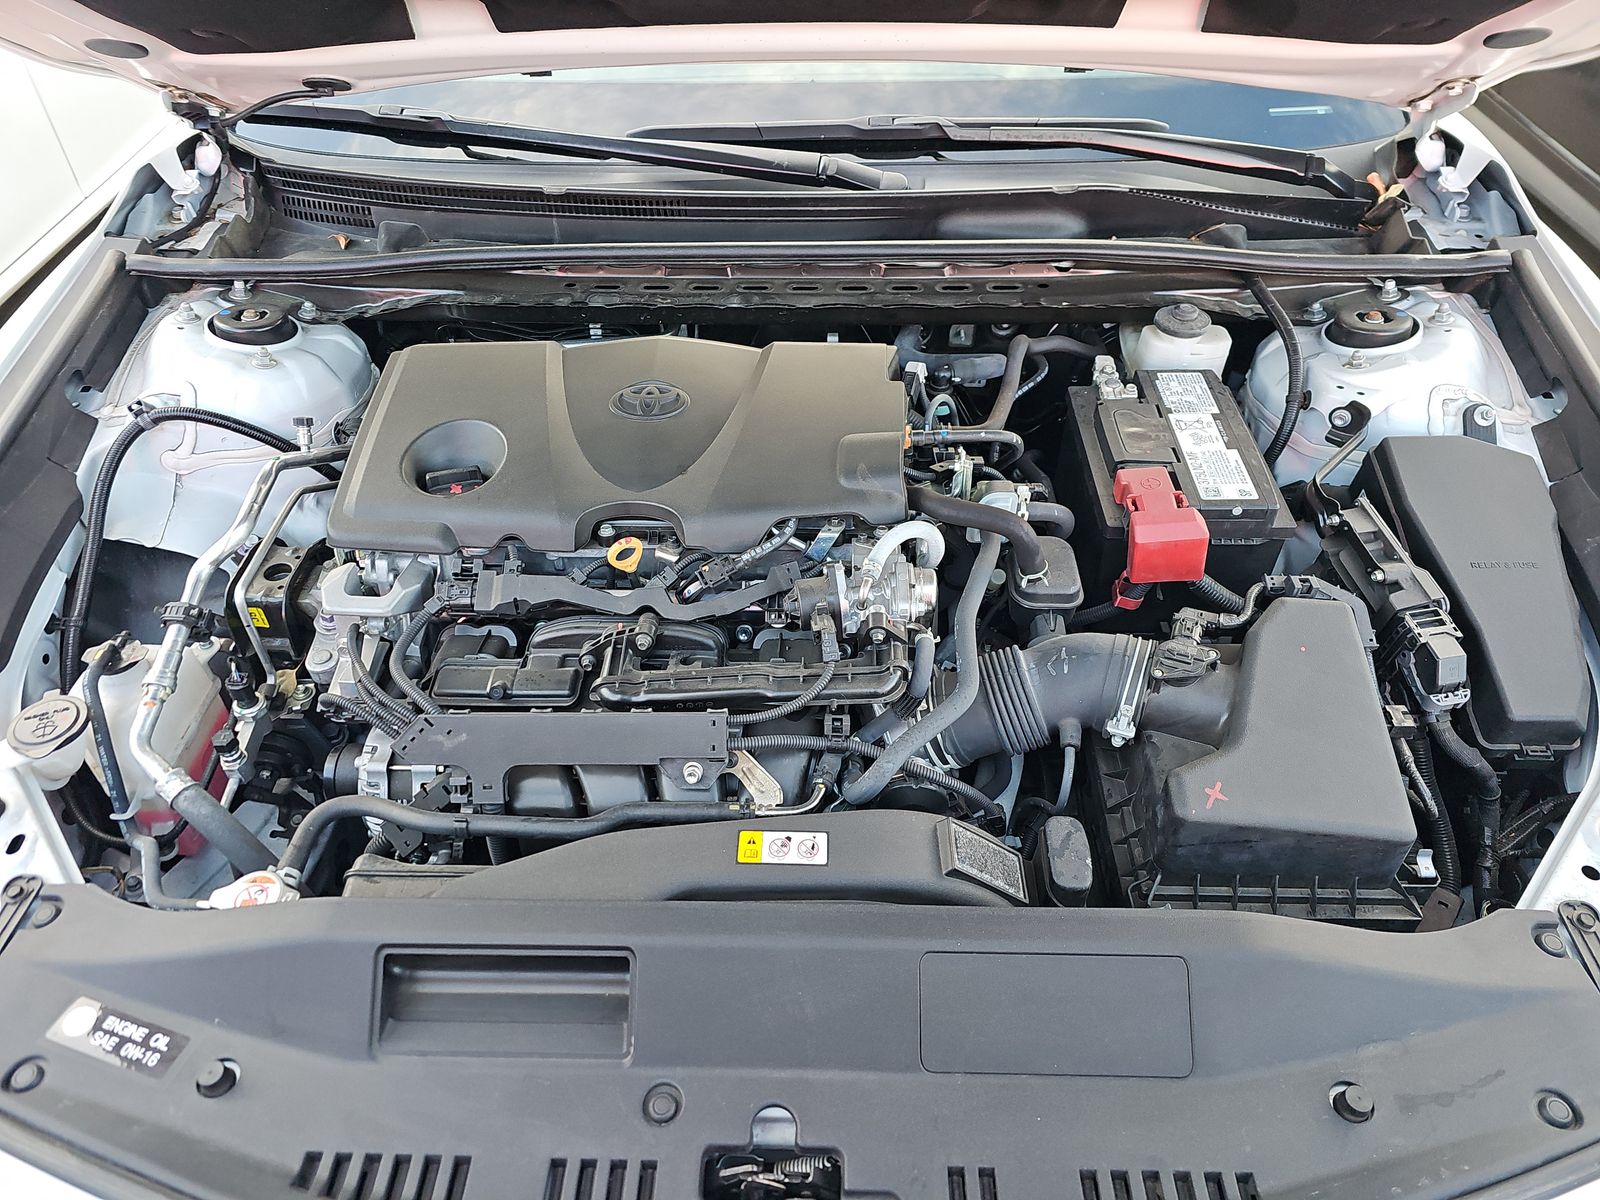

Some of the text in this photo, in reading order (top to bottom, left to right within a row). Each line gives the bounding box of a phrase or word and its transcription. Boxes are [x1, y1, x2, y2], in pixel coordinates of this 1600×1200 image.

[1469, 560, 1502, 569] RELAY
[89, 1030, 120, 1052] SAE
[101, 1014, 171, 1053] ENGINE OIL
